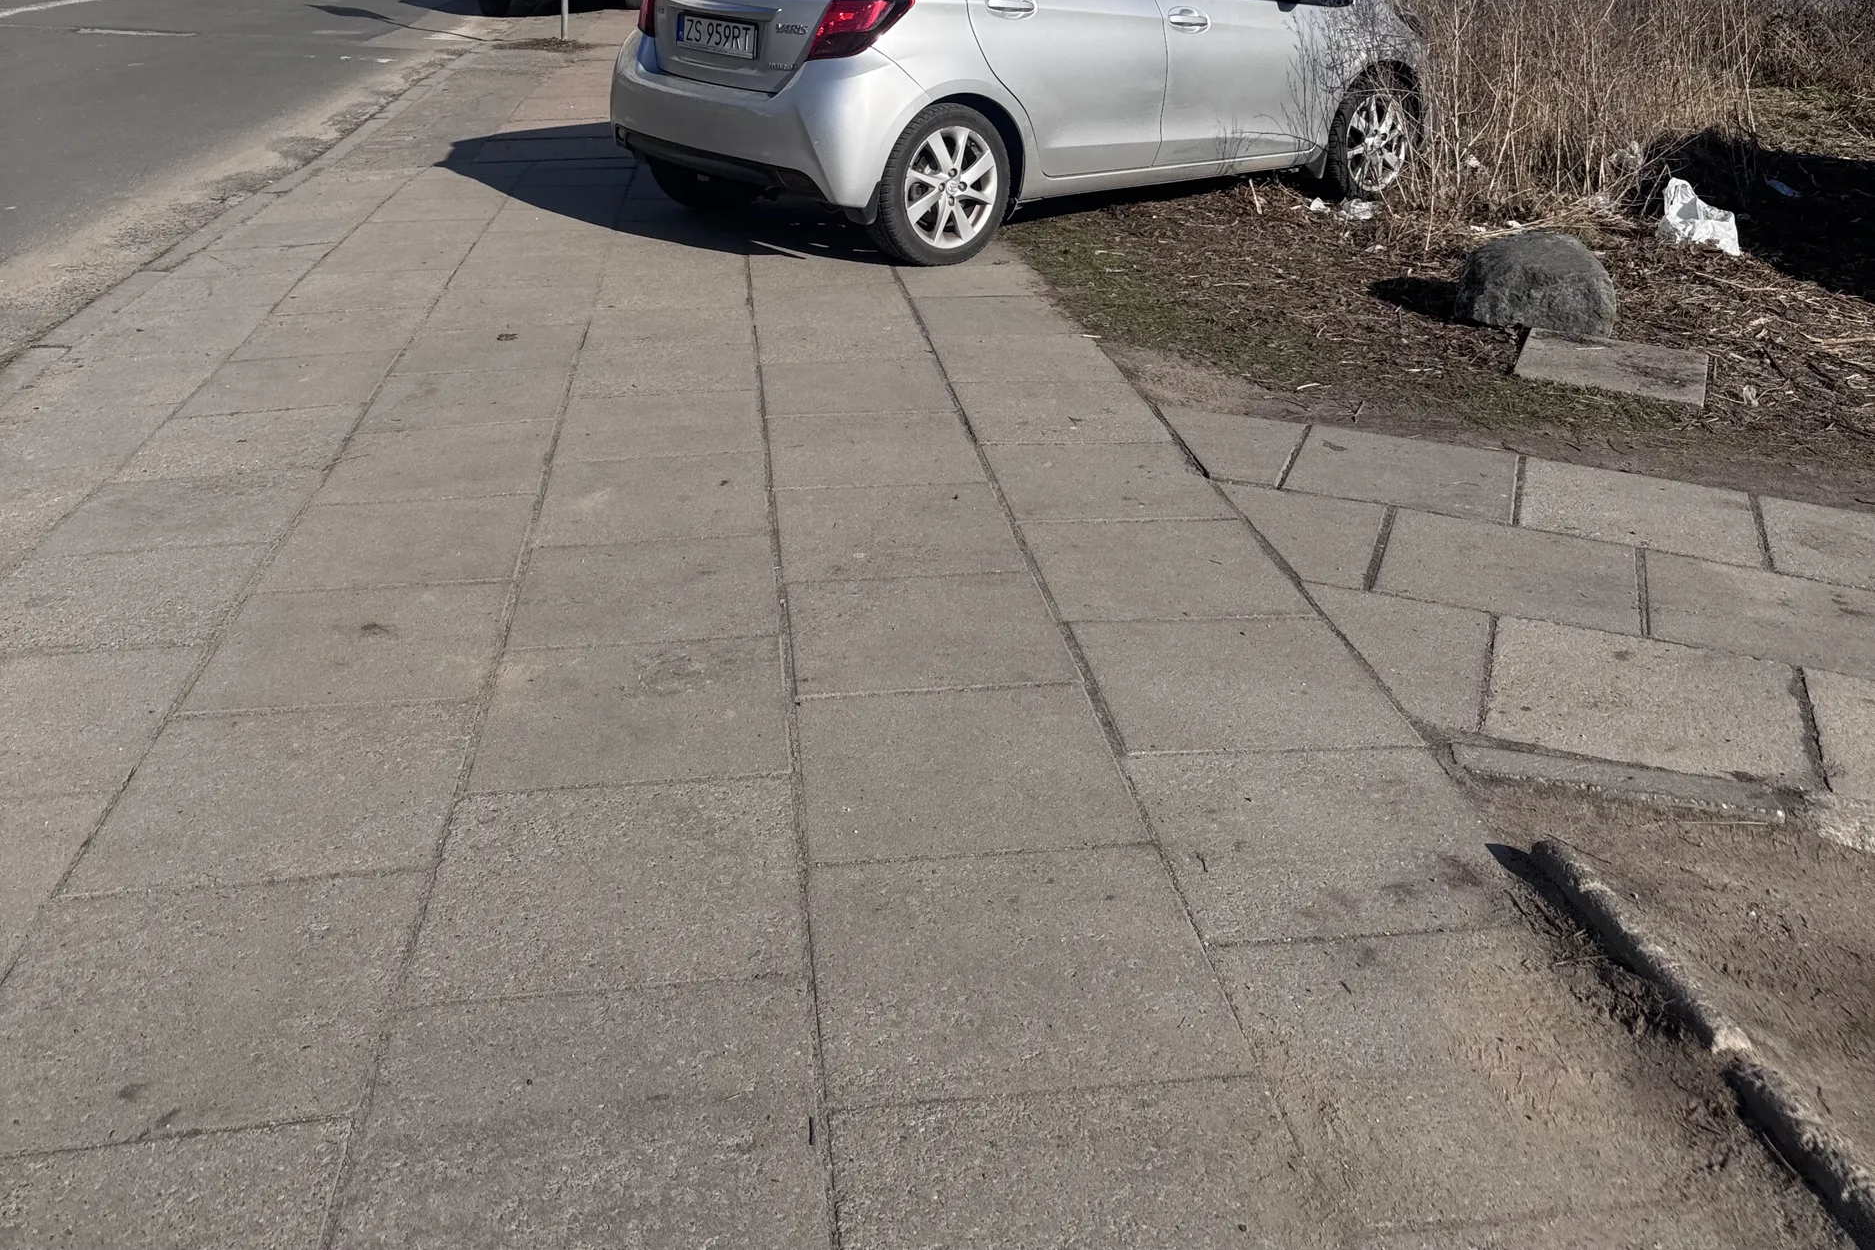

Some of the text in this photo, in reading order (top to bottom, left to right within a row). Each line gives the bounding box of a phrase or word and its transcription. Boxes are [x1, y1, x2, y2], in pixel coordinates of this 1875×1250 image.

[685, 18, 752, 51] ZS 959RT
[775, 22, 809, 36] YARIS
